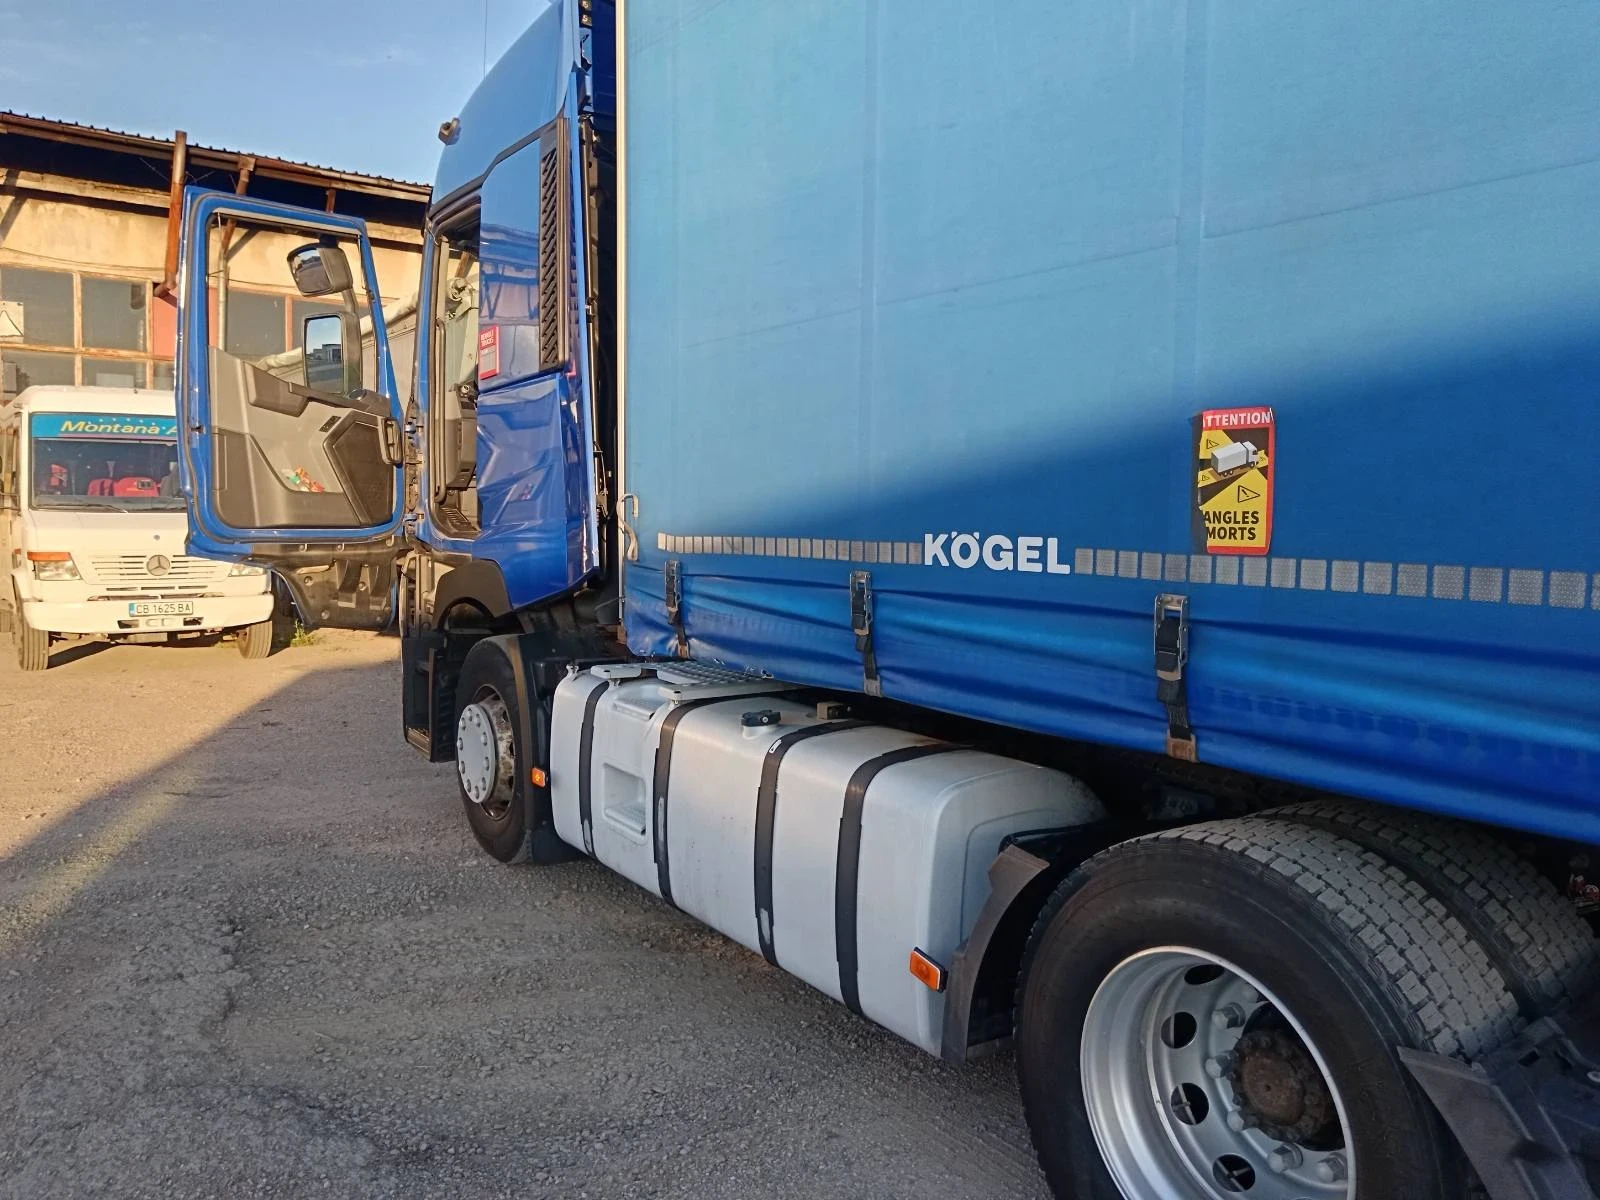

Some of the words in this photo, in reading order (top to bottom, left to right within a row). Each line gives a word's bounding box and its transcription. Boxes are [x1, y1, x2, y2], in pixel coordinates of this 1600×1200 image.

[60, 420, 160, 434] Montana
[1204, 510, 1259, 524] ANGLES
[1206, 526, 1256, 540] MORTS
[924, 531, 1070, 574] KÖGEL
[152, 603, 175, 614] 1625
[177, 603, 190, 613] BA
